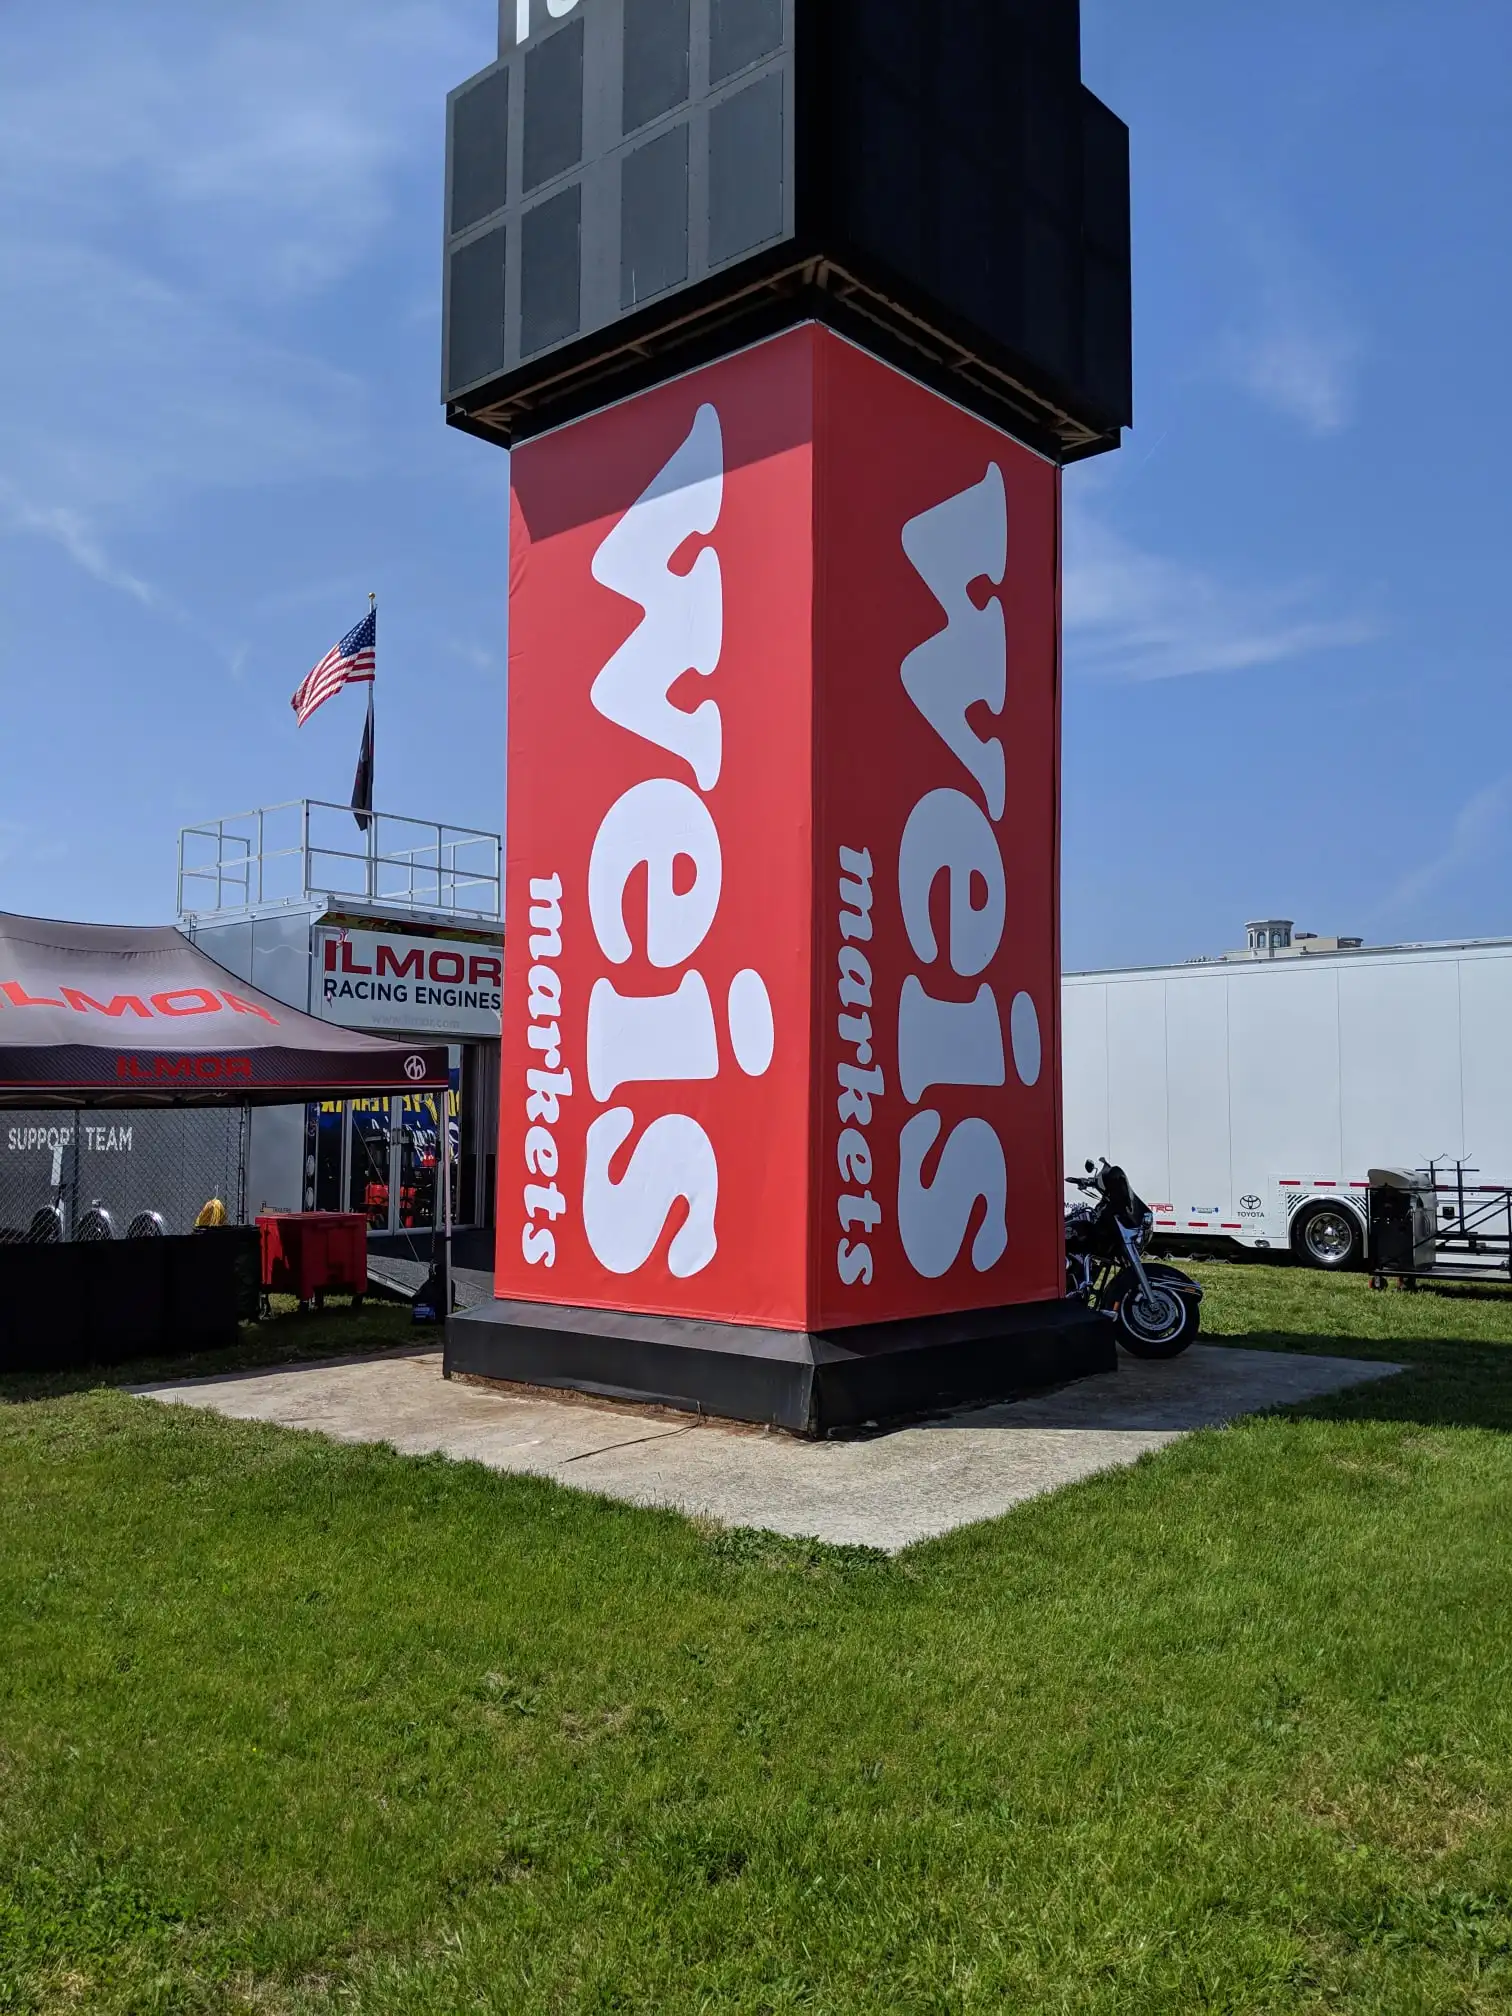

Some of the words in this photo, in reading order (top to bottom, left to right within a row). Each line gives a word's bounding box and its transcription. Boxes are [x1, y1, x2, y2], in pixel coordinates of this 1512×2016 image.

[582, 402, 775, 1279] weis
[897, 461, 1042, 1279] weis
[325, 940, 501, 987] ILMOR
[0, 981, 280, 1026] LMOR
[324, 978, 408, 1003] RACING
[415, 986, 501, 1010] ENGINES
[116, 1056, 252, 1079] ILMOR
[521, 871, 573, 1269] markets
[837, 845, 885, 1287] markets
[85, 1126, 133, 1151] TEAM
[1237, 1211, 1265, 1219] TOYOTA
